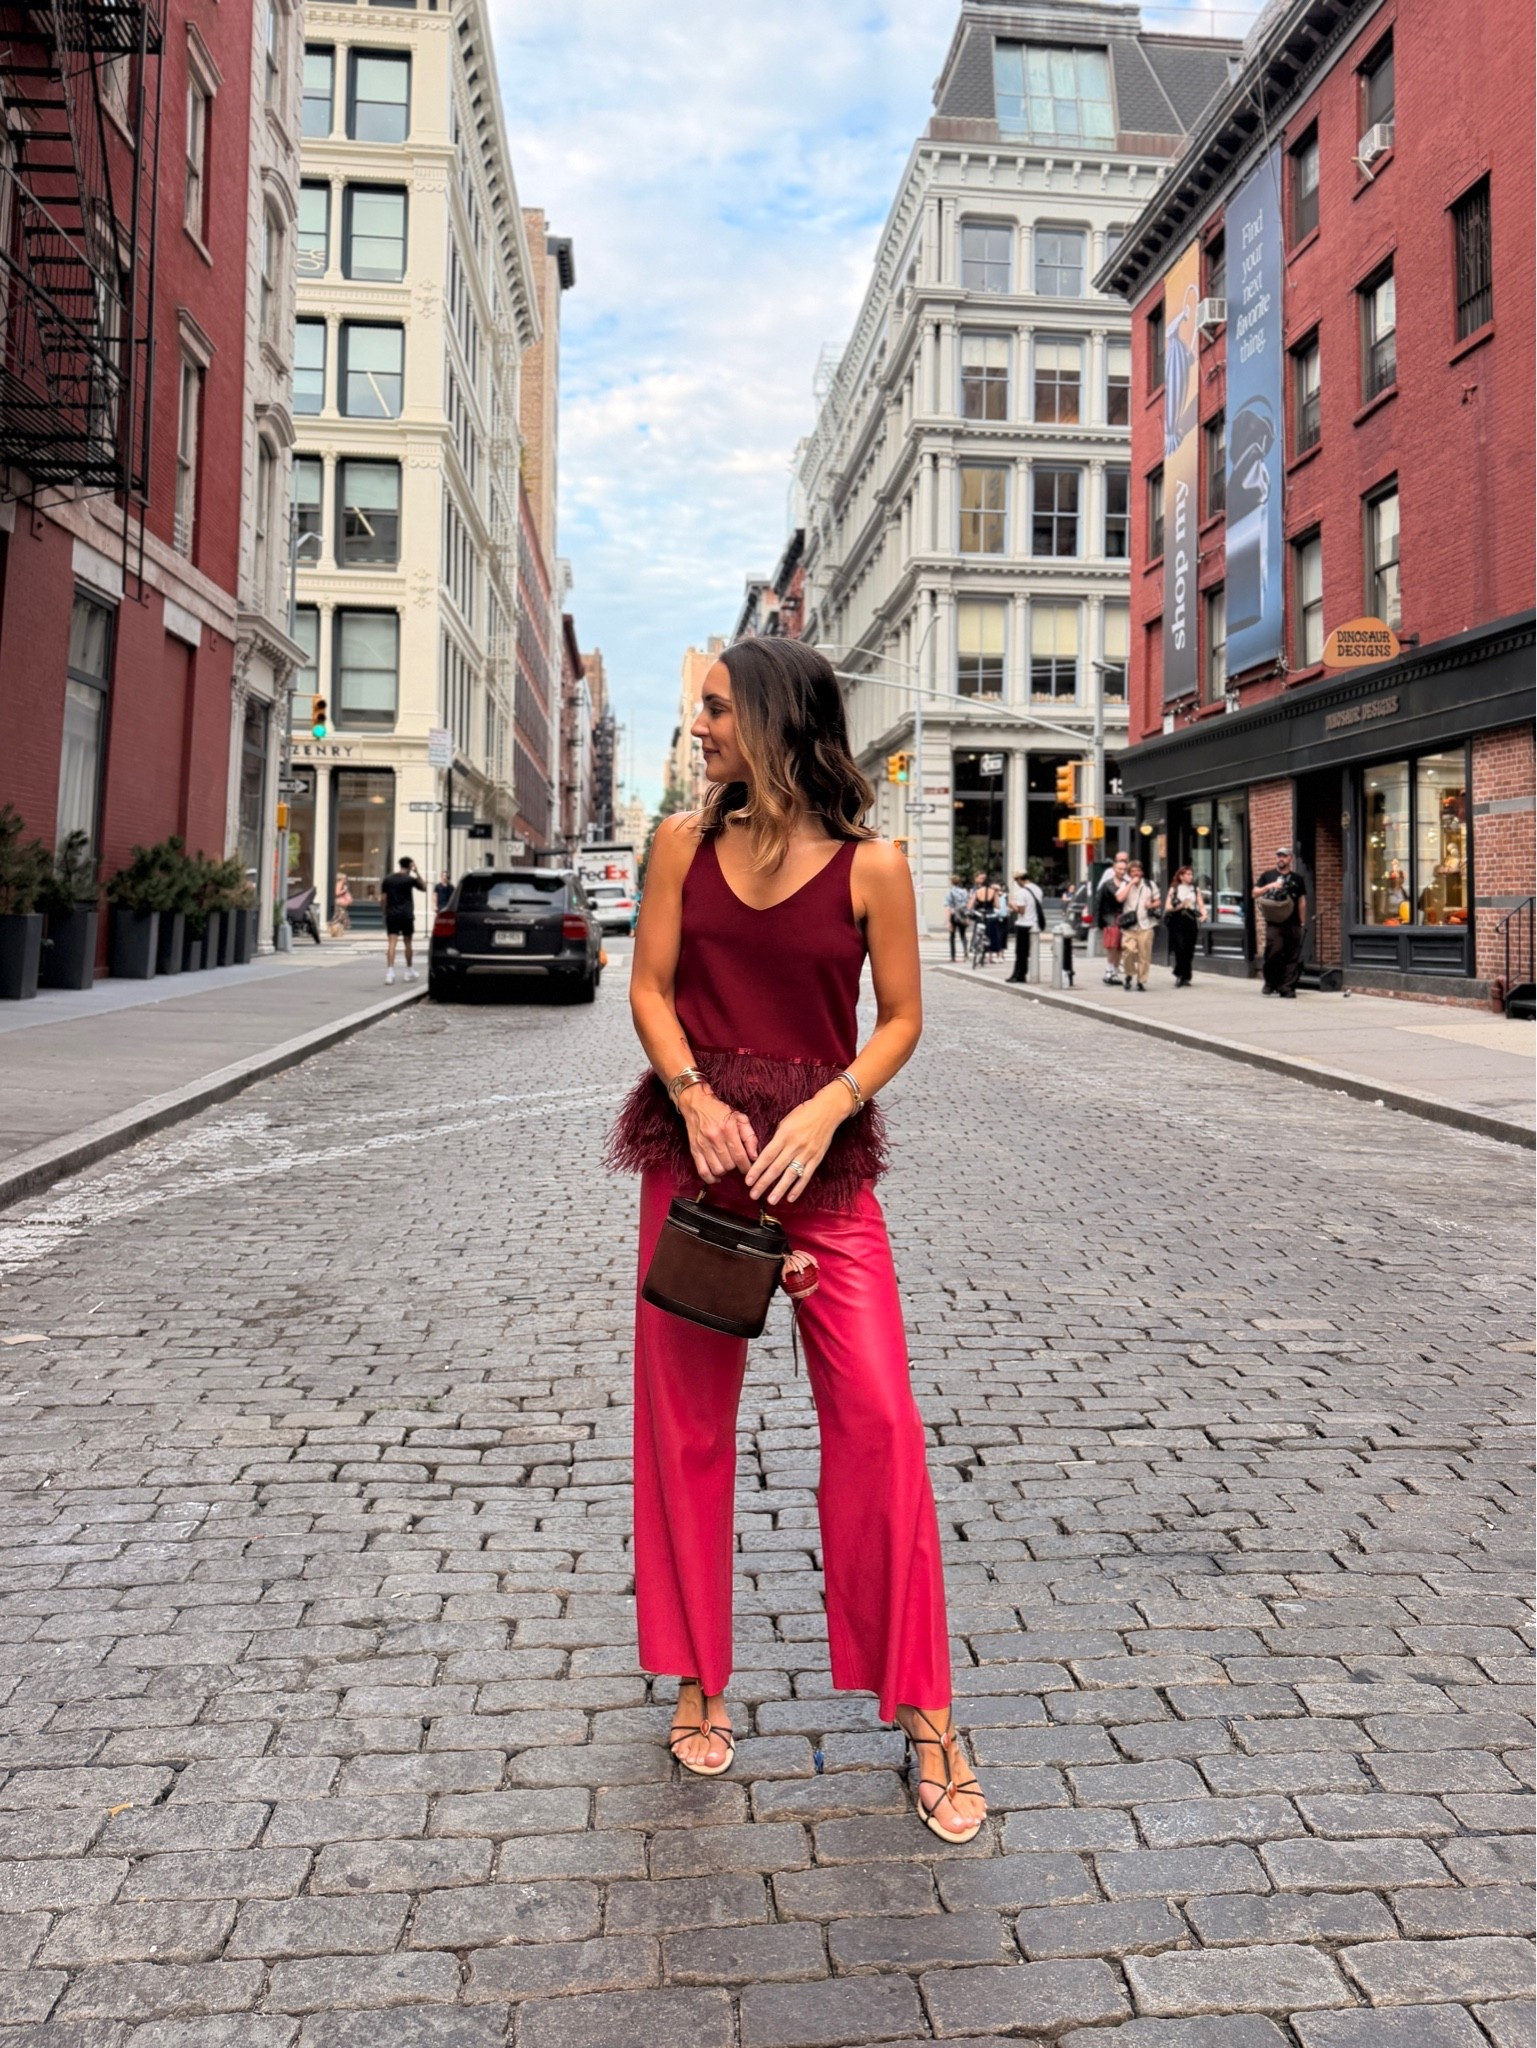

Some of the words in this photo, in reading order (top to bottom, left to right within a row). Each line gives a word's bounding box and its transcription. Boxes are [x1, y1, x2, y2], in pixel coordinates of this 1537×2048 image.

[1241, 208, 1264, 250] Find
[1241, 242, 1264, 284] your
[1242, 271, 1263, 306] next
[1235, 293, 1272, 341] favorite
[1175, 479, 1190, 543] my
[1171, 550, 1189, 651] shop
[1336, 630, 1391, 644] DINOSAUR
[1337, 644, 1391, 658] DESIGNS
[1361, 695, 1399, 721] DESIGNS
[578, 864, 630, 881] FedEx
